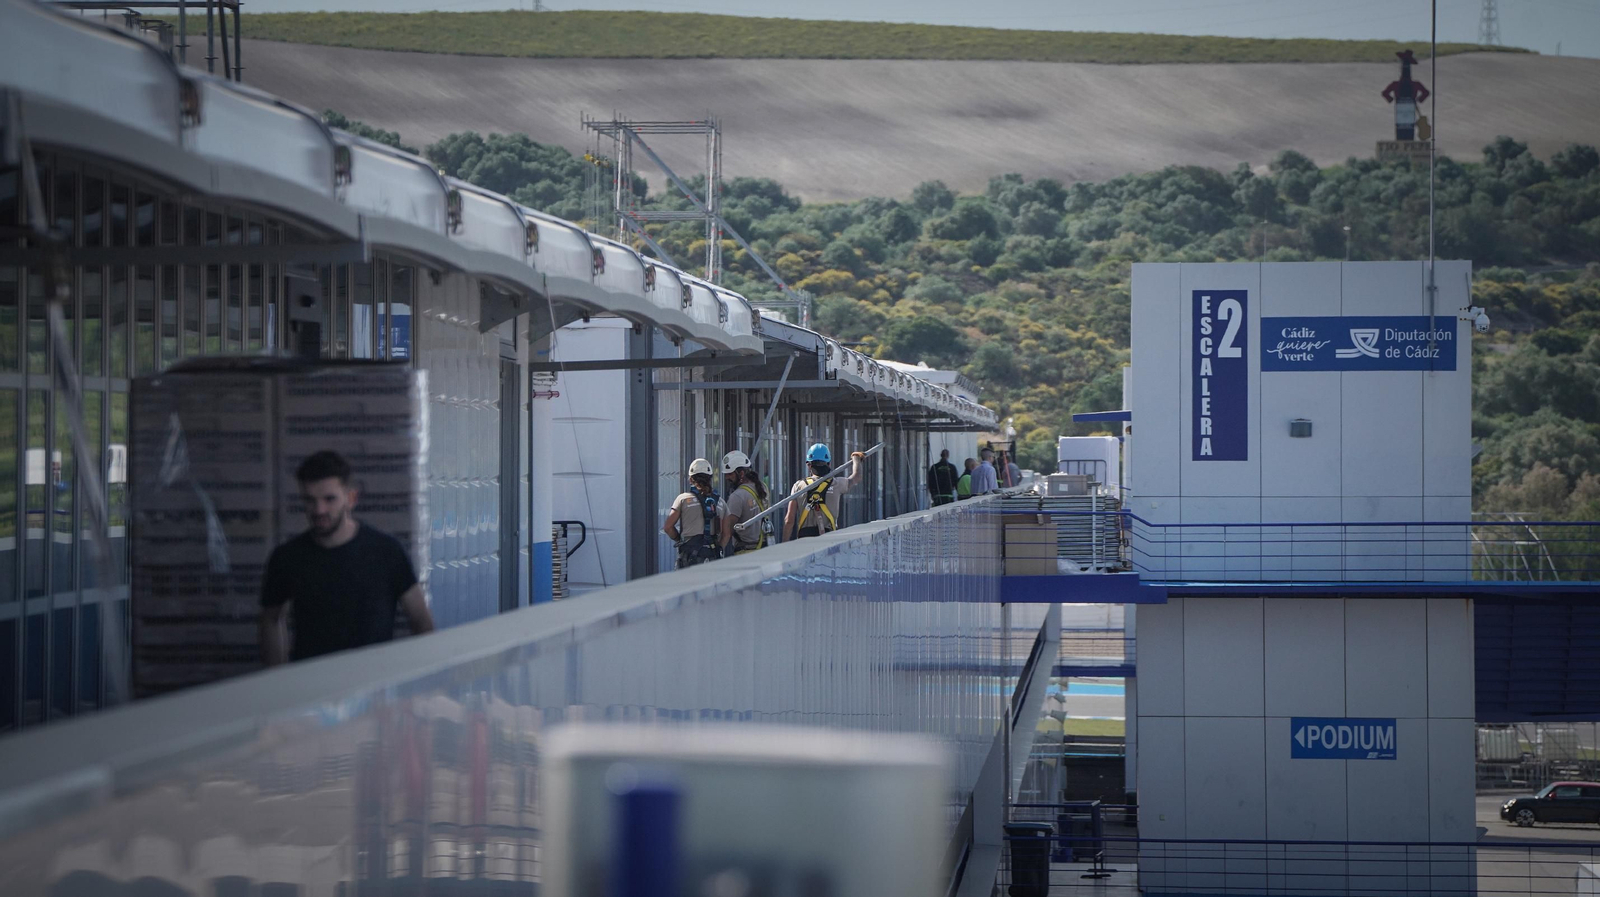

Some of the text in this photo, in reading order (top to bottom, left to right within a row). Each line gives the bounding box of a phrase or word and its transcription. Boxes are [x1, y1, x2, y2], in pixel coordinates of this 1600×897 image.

[1217, 298, 1243, 358] 2
[1281, 326, 1316, 339] Cádiz
[1385, 327, 1452, 343] Diputación
[1266, 339, 1331, 359] quiere
[1283, 351, 1314, 362] verte
[1385, 345, 1440, 359] de Cádiz
[1200, 295, 1213, 456] ESCALERA
[1307, 725, 1394, 750] PODIUM
